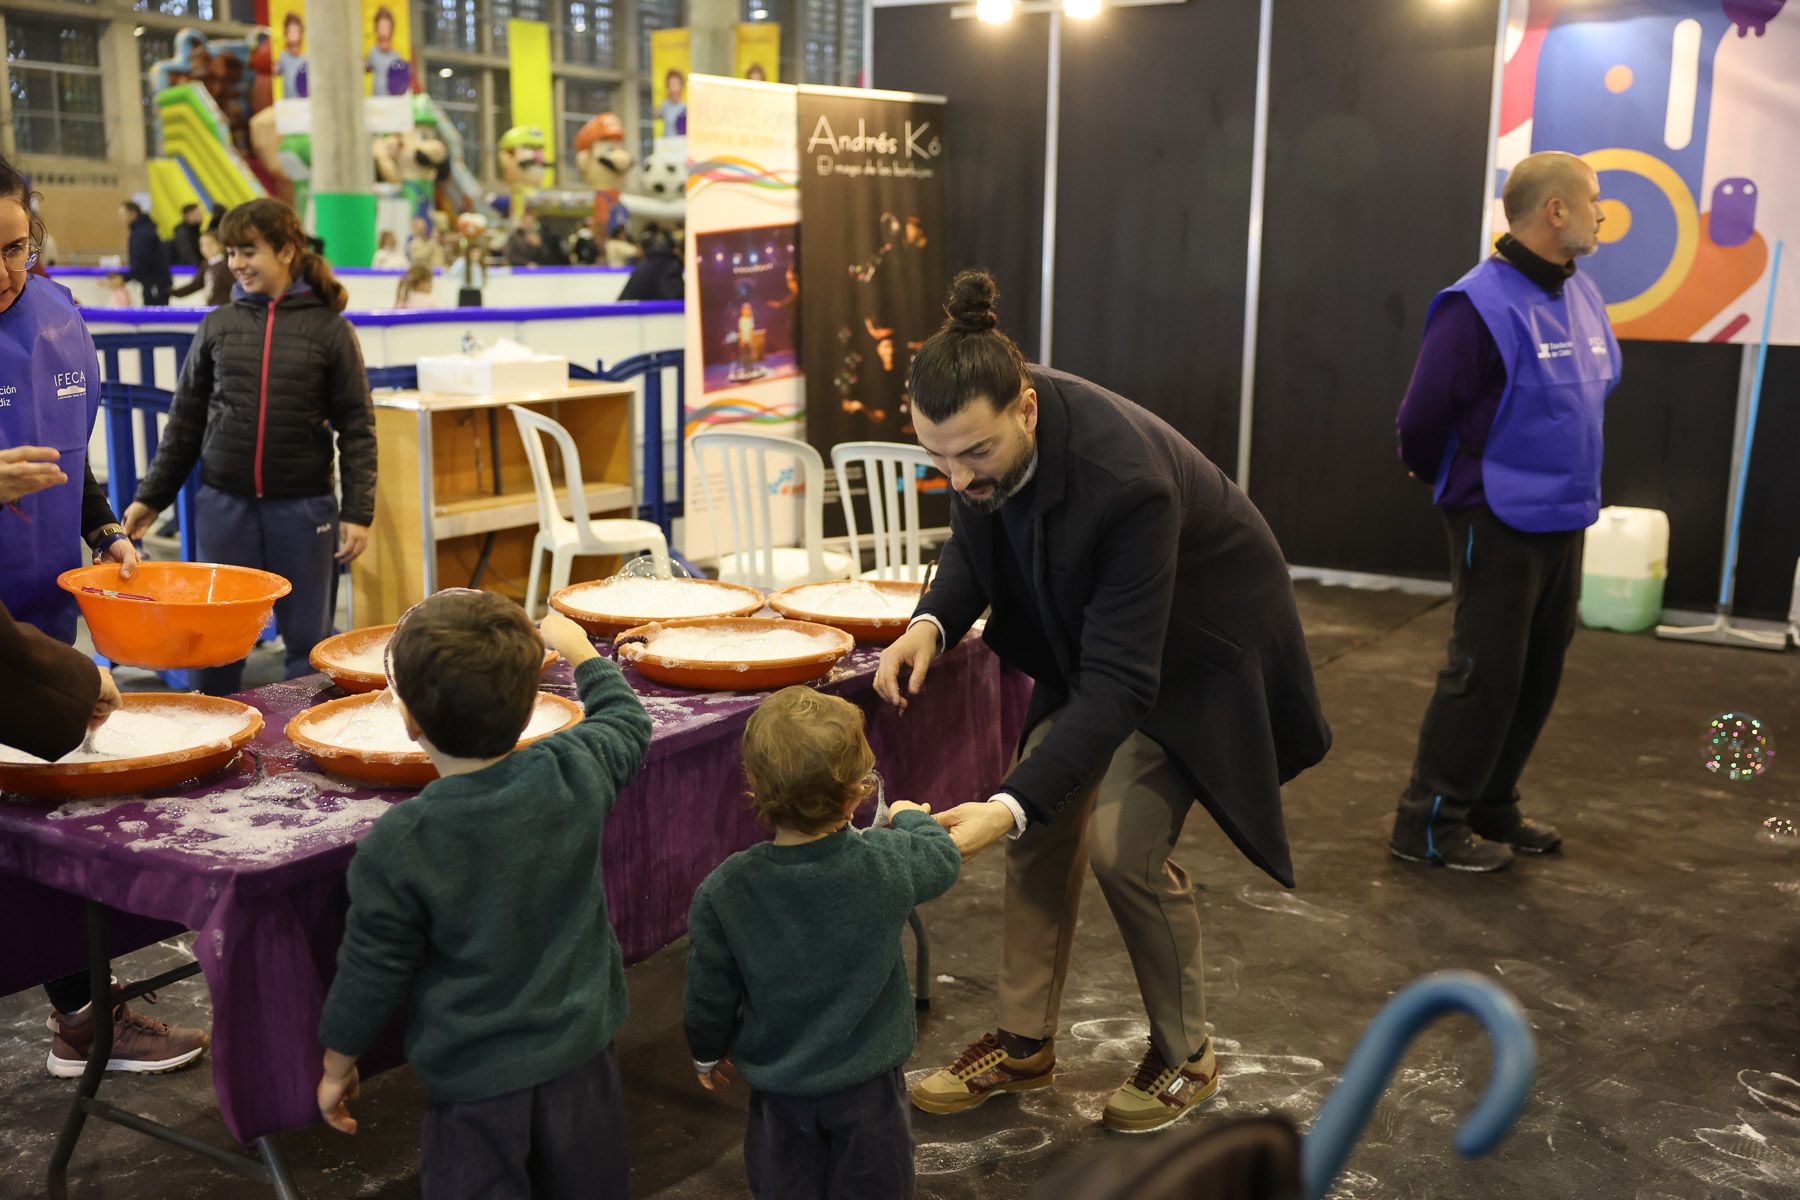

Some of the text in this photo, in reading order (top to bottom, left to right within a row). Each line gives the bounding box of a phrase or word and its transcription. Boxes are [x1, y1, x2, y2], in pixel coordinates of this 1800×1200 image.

[807, 115, 898, 155] Andrés
[905, 120, 942, 160] Kó
[54, 370, 86, 387] IFECA
